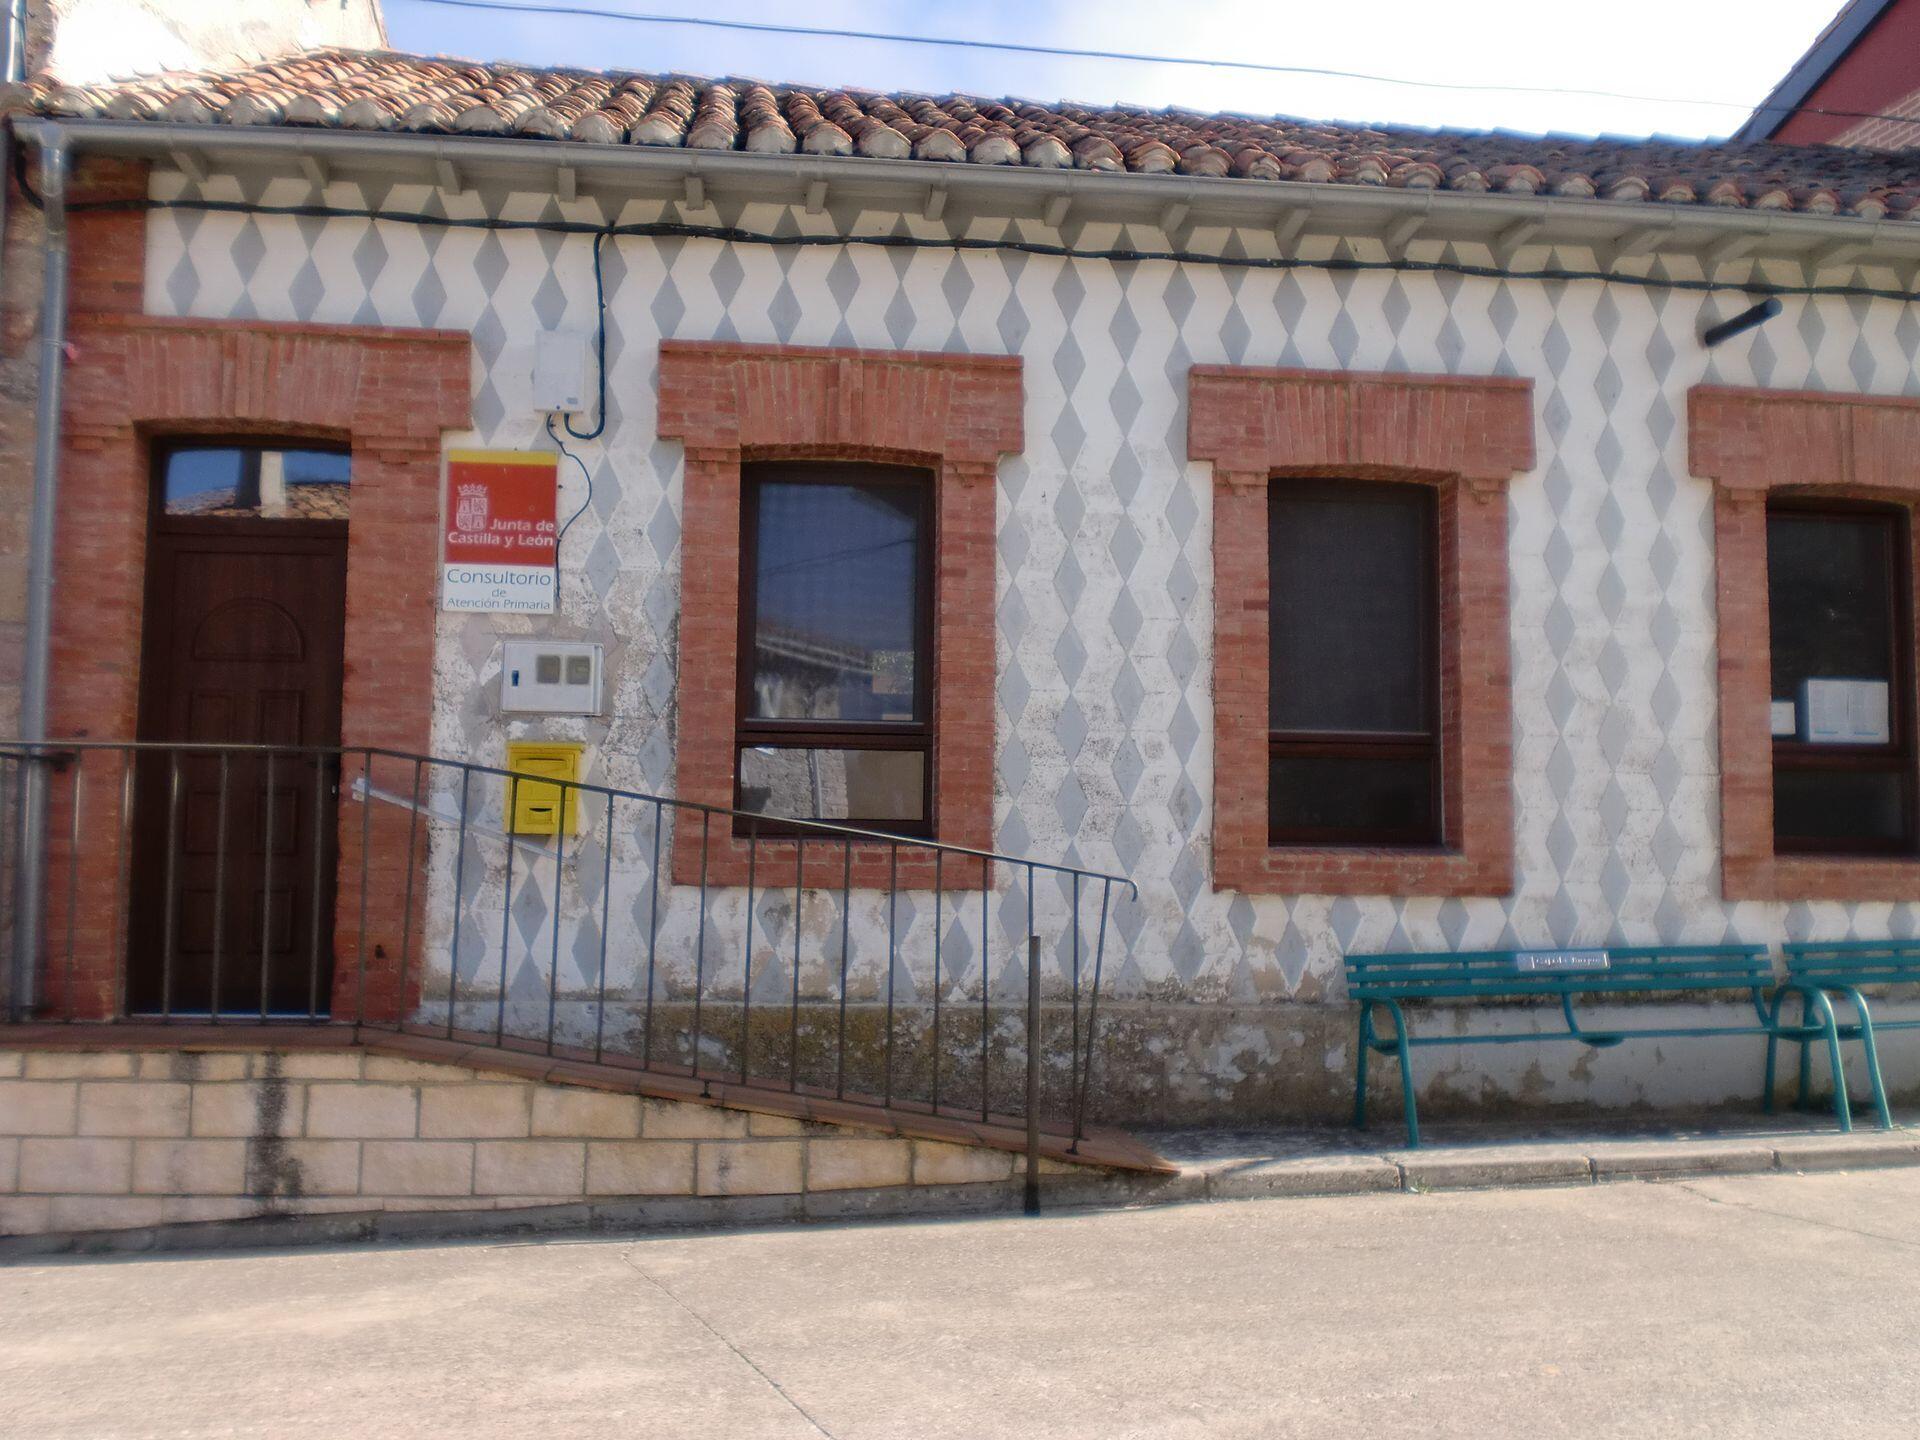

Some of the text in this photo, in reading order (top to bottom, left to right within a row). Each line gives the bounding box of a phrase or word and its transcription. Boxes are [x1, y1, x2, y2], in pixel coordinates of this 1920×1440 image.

[490, 518, 554, 532] Junta de
[448, 531, 554, 548] Castilla y León
[447, 568, 551, 586] Consultorio
[491, 588, 507, 598] de
[448, 598, 550, 611] Atención Primaria
